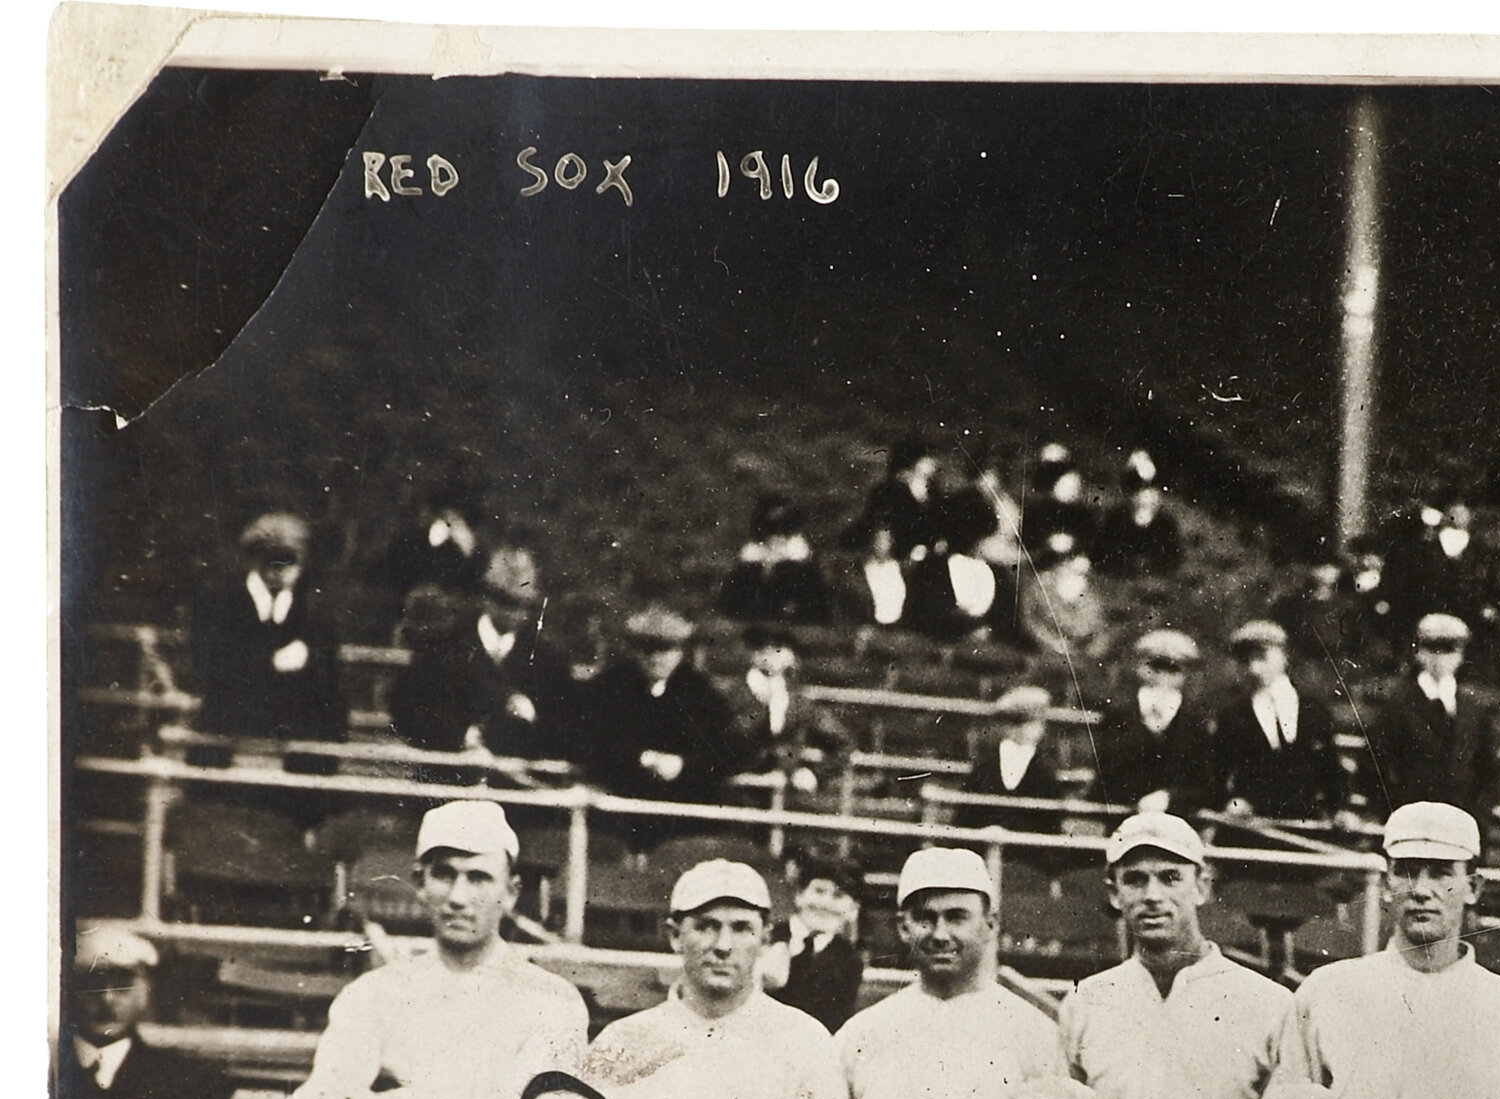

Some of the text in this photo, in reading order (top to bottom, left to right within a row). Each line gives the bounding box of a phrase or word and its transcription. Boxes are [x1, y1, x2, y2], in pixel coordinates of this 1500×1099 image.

[362, 145, 840, 207] RED SOX 1916
